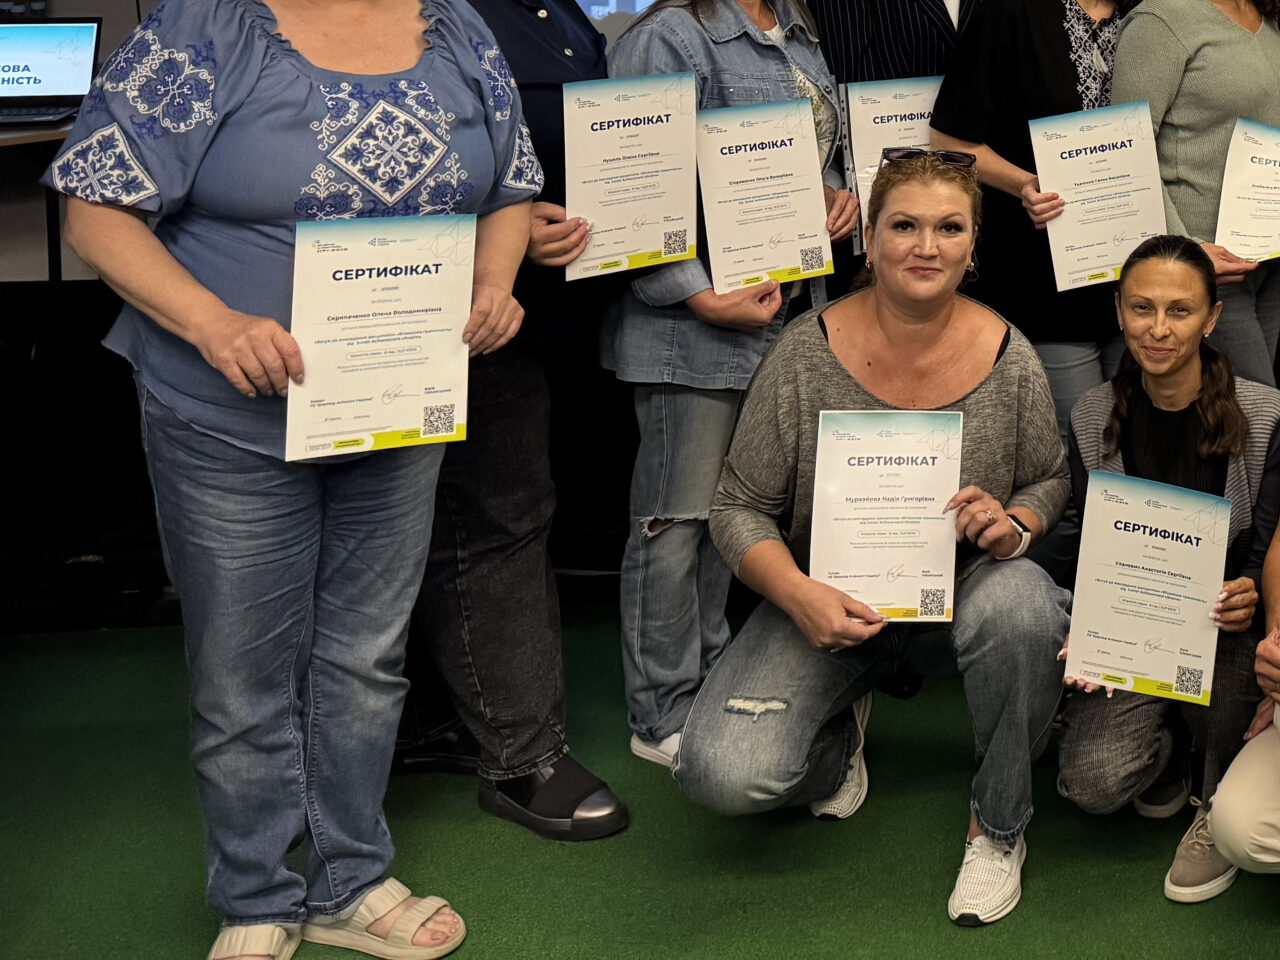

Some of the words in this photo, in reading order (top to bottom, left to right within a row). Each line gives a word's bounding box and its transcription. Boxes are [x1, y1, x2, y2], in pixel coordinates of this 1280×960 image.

[0, 64, 31, 73] ОВА
[590, 113, 672, 132] СЕРТИФІКАТ
[872, 111, 933, 125] СЕРТИФІКА
[720, 137, 794, 156] СЕРТИФІКАТ
[1060, 139, 1134, 160] СЕРТИФІКАТ
[331, 263, 443, 281] СЕРТИФІКАТ
[847, 455, 938, 467] СЕРТИФІКАТ
[1113, 520, 1203, 548] СЕРТИФІКАТ
